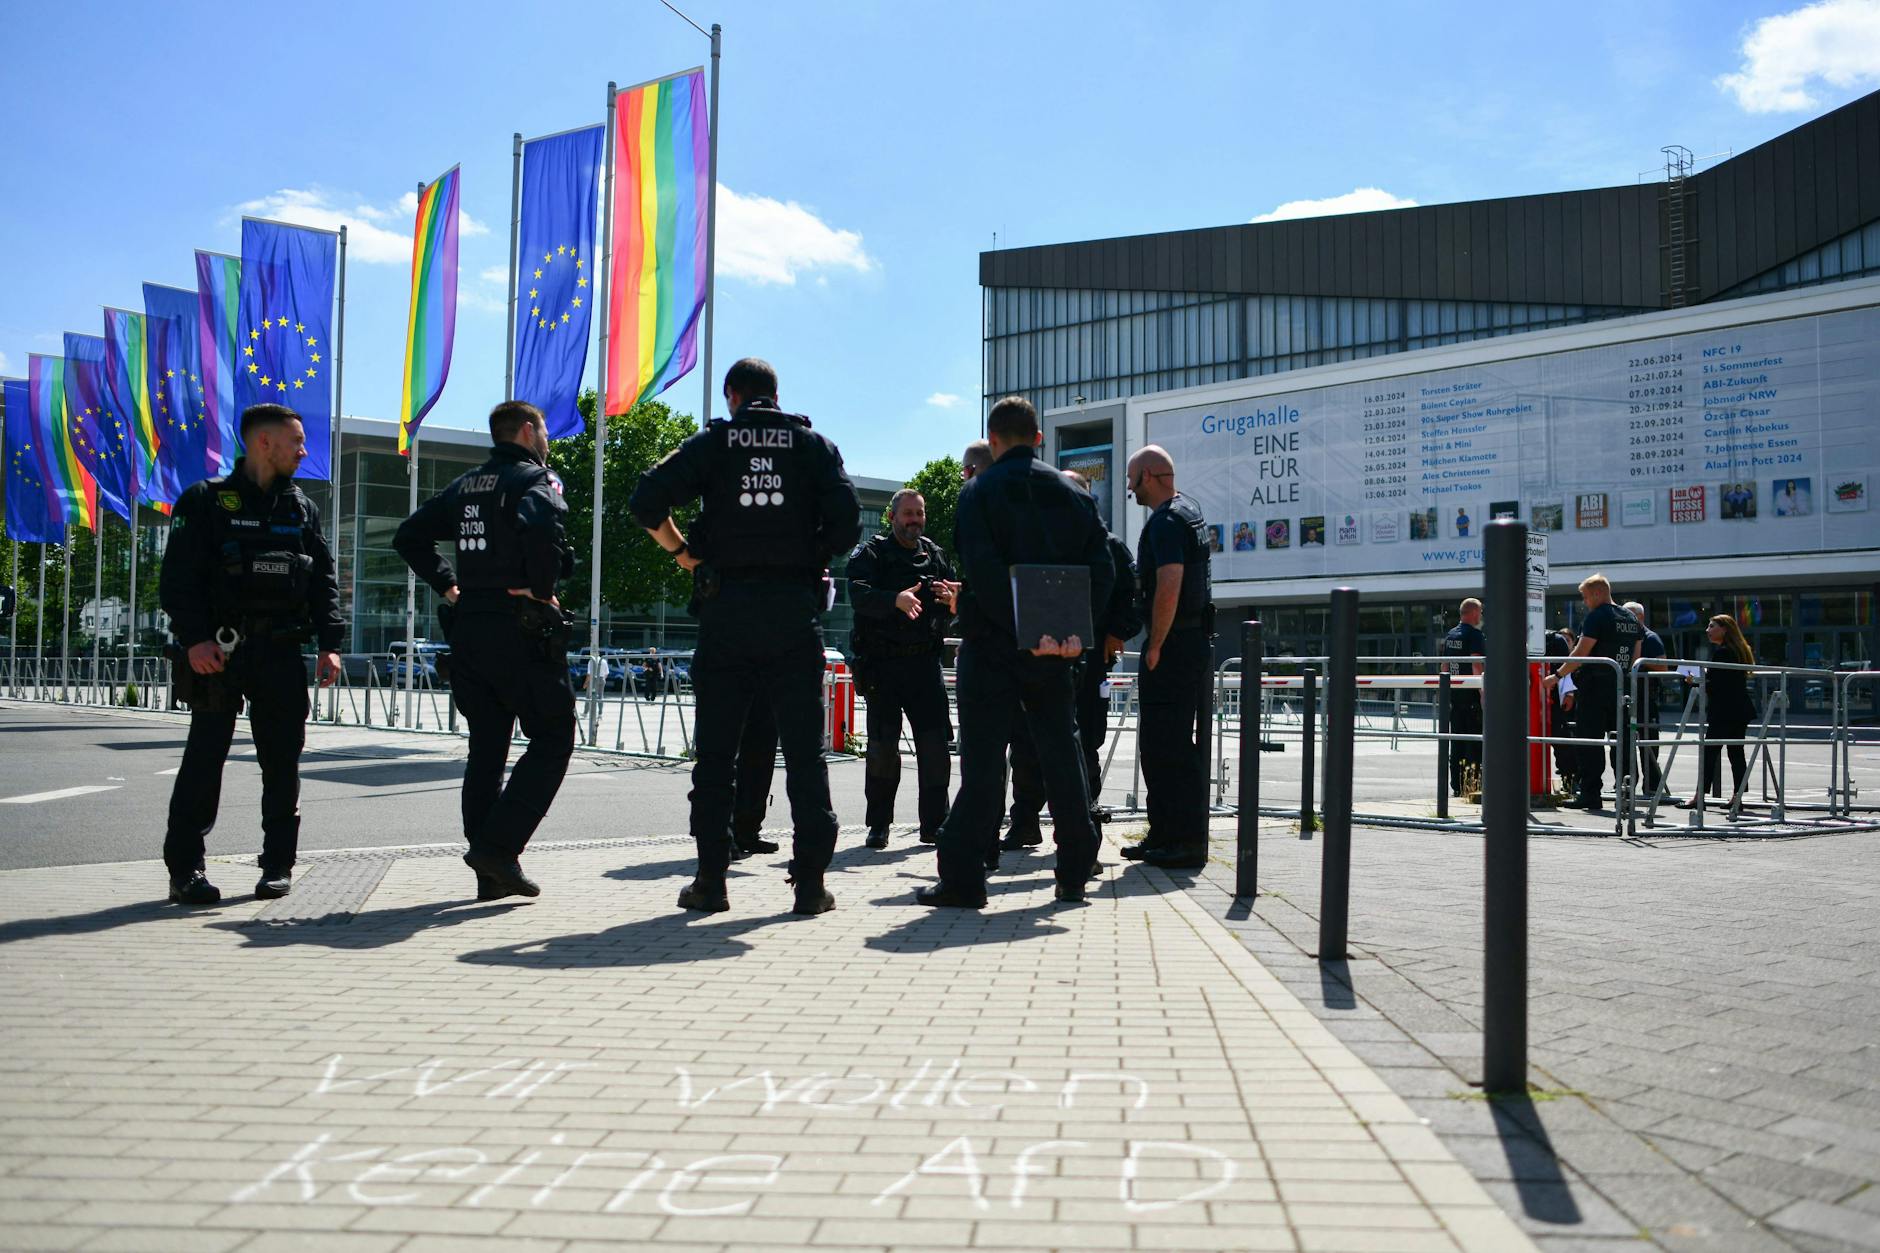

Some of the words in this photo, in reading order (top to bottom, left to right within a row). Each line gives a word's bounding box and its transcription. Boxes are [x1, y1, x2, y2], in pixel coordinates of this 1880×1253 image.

[1628, 353, 1682, 368] 22.06.2024
[1703, 347, 1726, 358] NFC
[1730, 345, 1742, 354] 19
[1720, 357, 1783, 372] Sommerfest
[1421, 387, 1450, 396] Torsten
[1453, 382, 1483, 392] Sträter
[1629, 385, 1683, 398] 07.09.2024
[1704, 374, 1768, 390] ABI-Zukunft
[1748, 390, 1777, 400] NRW
[1364, 406, 1406, 418] 22.03.2024
[1421, 400, 1447, 410] Bülent
[1450, 398, 1477, 408] Ceylan
[1364, 420, 1406, 431] 23.03.2024
[1436, 414, 1459, 425] Super
[1462, 410, 1483, 419] Show
[1486, 404, 1532, 418] Ruhrgebiet
[1202, 405, 1299, 436] Grugahalle
[1630, 417, 1684, 430] 22.09.2024
[1704, 410, 1736, 422] Özcan
[727, 428, 793, 448] POLIZEI
[1364, 434, 1406, 445] 12.04.2024
[1422, 428, 1449, 438] Steffen
[1452, 424, 1487, 434] Henssler
[1630, 432, 1684, 445] 26.09.2024
[1704, 427, 1742, 438] Carolin
[1745, 423, 1790, 434] Kebekus
[1254, 432, 1299, 456] EINE
[1422, 444, 1444, 452] Mami
[1454, 440, 1472, 448] Mini
[1630, 448, 1684, 460] 28.09.2024
[1716, 440, 1764, 454] Jobmesse
[1768, 438, 1798, 448] Essen
[750, 457, 773, 472] SN
[1260, 455, 1299, 480] FÜR
[1364, 462, 1406, 473] 26.05.2024
[1459, 452, 1497, 462] Klamotte
[1630, 464, 1685, 476] 09.11.2024
[1705, 460, 1732, 470] Alaaf
[1751, 456, 1774, 465] Pott
[1777, 454, 1802, 464] 2024
[742, 474, 782, 490] 31/30
[1422, 472, 1440, 480] Alex
[1442, 468, 1490, 478] Christensen
[459, 475, 499, 494] POLIZEI
[1422, 485, 1452, 494] Michael
[1454, 482, 1482, 491] Tsokos
[1250, 483, 1299, 506] ALLE
[1581, 494, 1603, 510] ABI
[464, 504, 480, 518] SN
[1673, 500, 1702, 510] MESSE
[1581, 519, 1603, 528] MESSE
[1673, 511, 1703, 522] ESSEN
[460, 521, 485, 535] 31/30
[1528, 536, 1543, 546] arken
[255, 563, 288, 572] POLIZEI
[869, 1134, 1240, 1213] AfD
